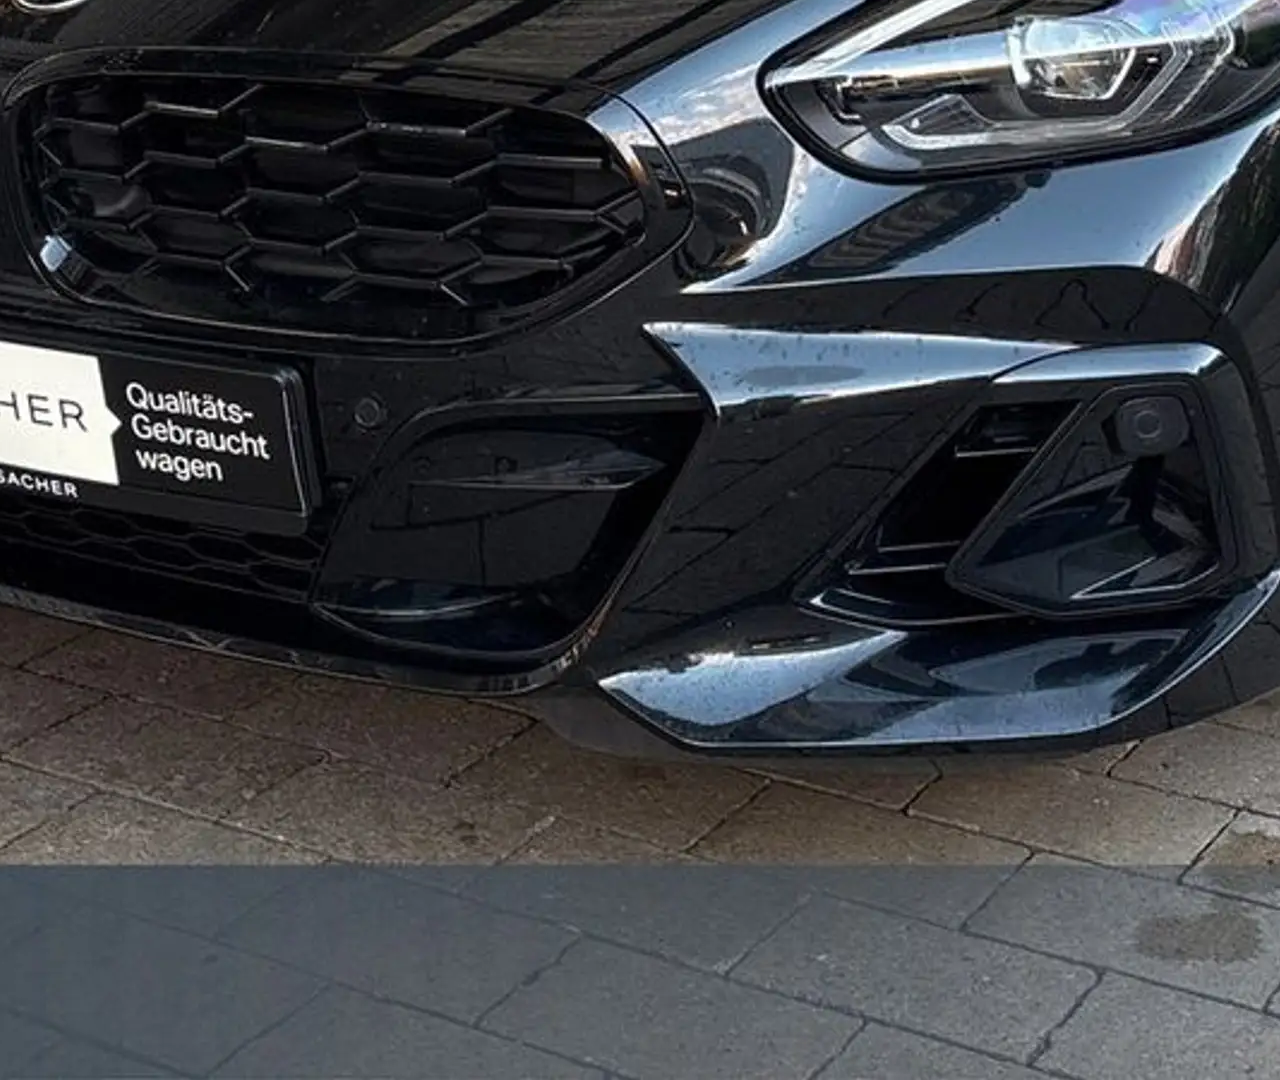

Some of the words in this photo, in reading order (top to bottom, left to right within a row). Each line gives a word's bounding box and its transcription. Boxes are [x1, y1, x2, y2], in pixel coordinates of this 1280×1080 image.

[125, 381, 254, 424] Qualitäts-
[131, 413, 270, 460] Gebraucht
[135, 449, 224, 482] wagen
